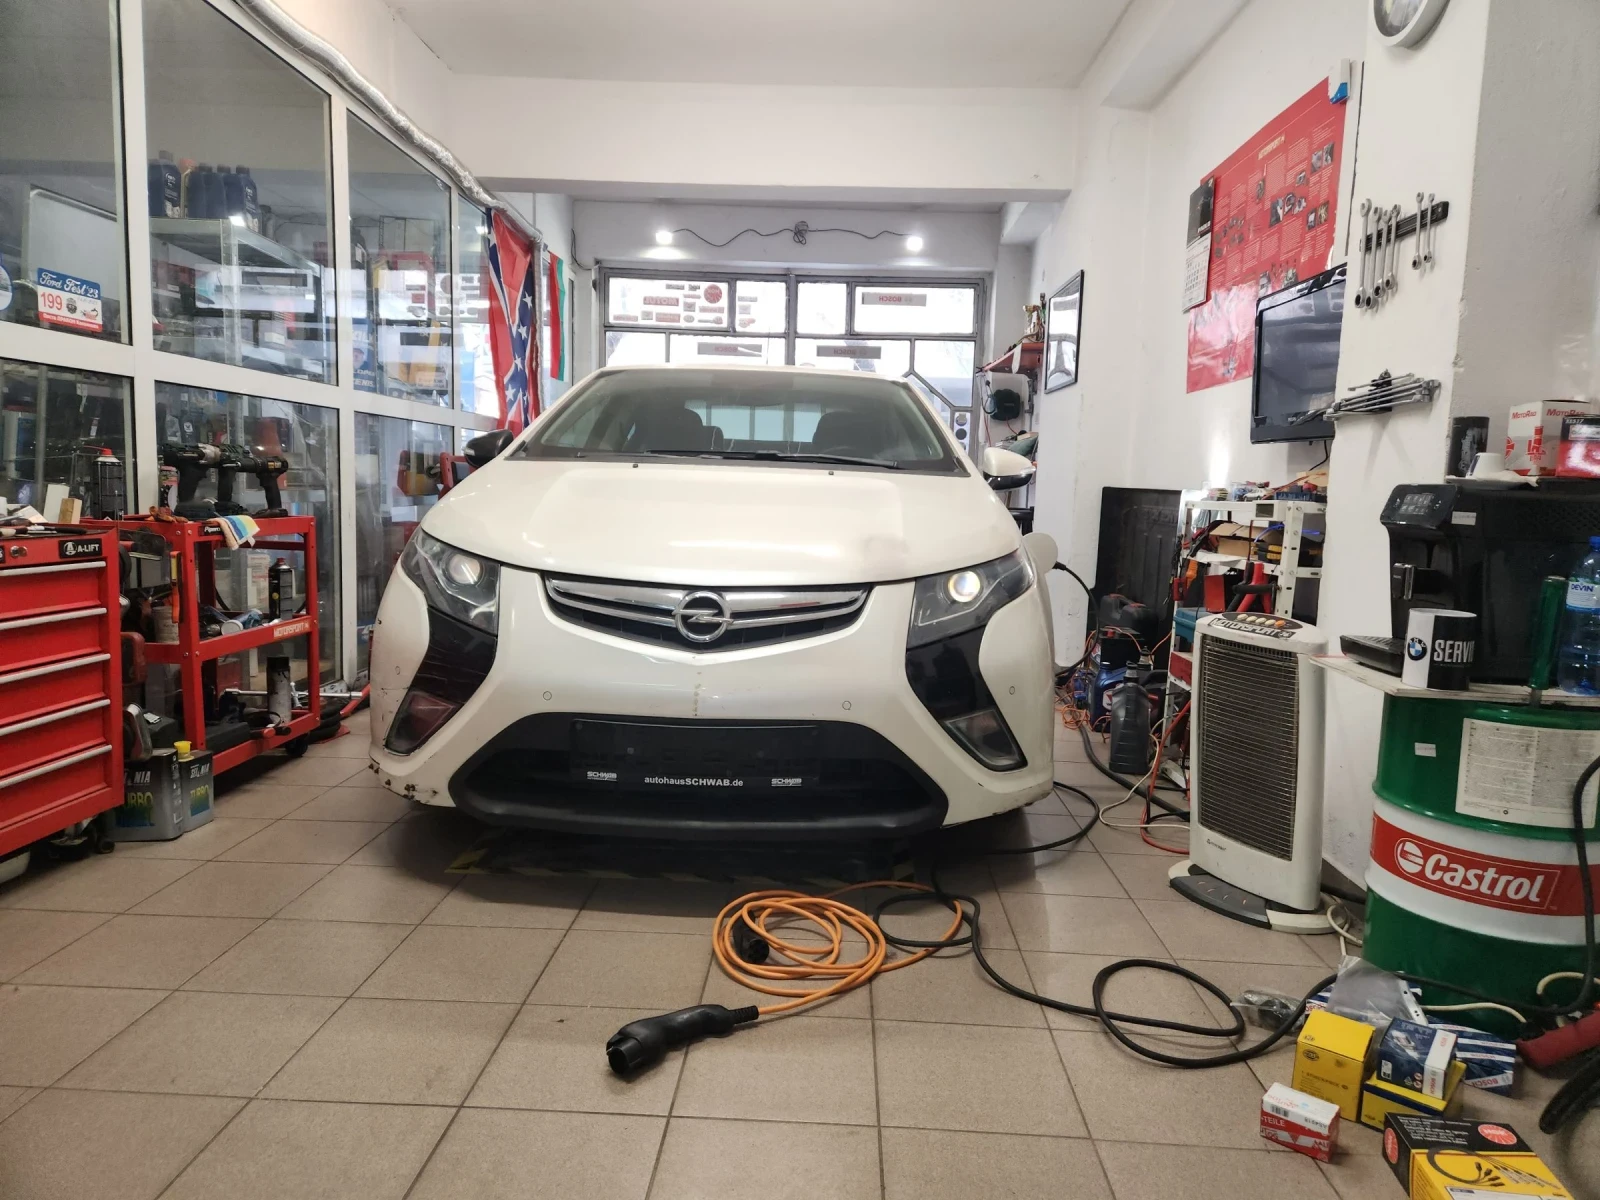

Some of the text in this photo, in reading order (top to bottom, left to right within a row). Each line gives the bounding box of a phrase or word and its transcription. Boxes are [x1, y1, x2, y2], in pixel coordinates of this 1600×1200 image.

[40, 272, 62, 288] Ford
[41, 292, 62, 310] 199
[77, 544, 100, 553] A-LIFT
[1571, 584, 1594, 592] DEVIN
[1210, 618, 1277, 636] MOTORSPORT
[587, 770, 617, 780] SCHWAB
[644, 776, 744, 787] autohausSCHWAB.de
[771, 778, 802, 786] SCHWAB
[1424, 853, 1545, 903] Castrol
[1472, 1077, 1499, 1088] BOSCH
